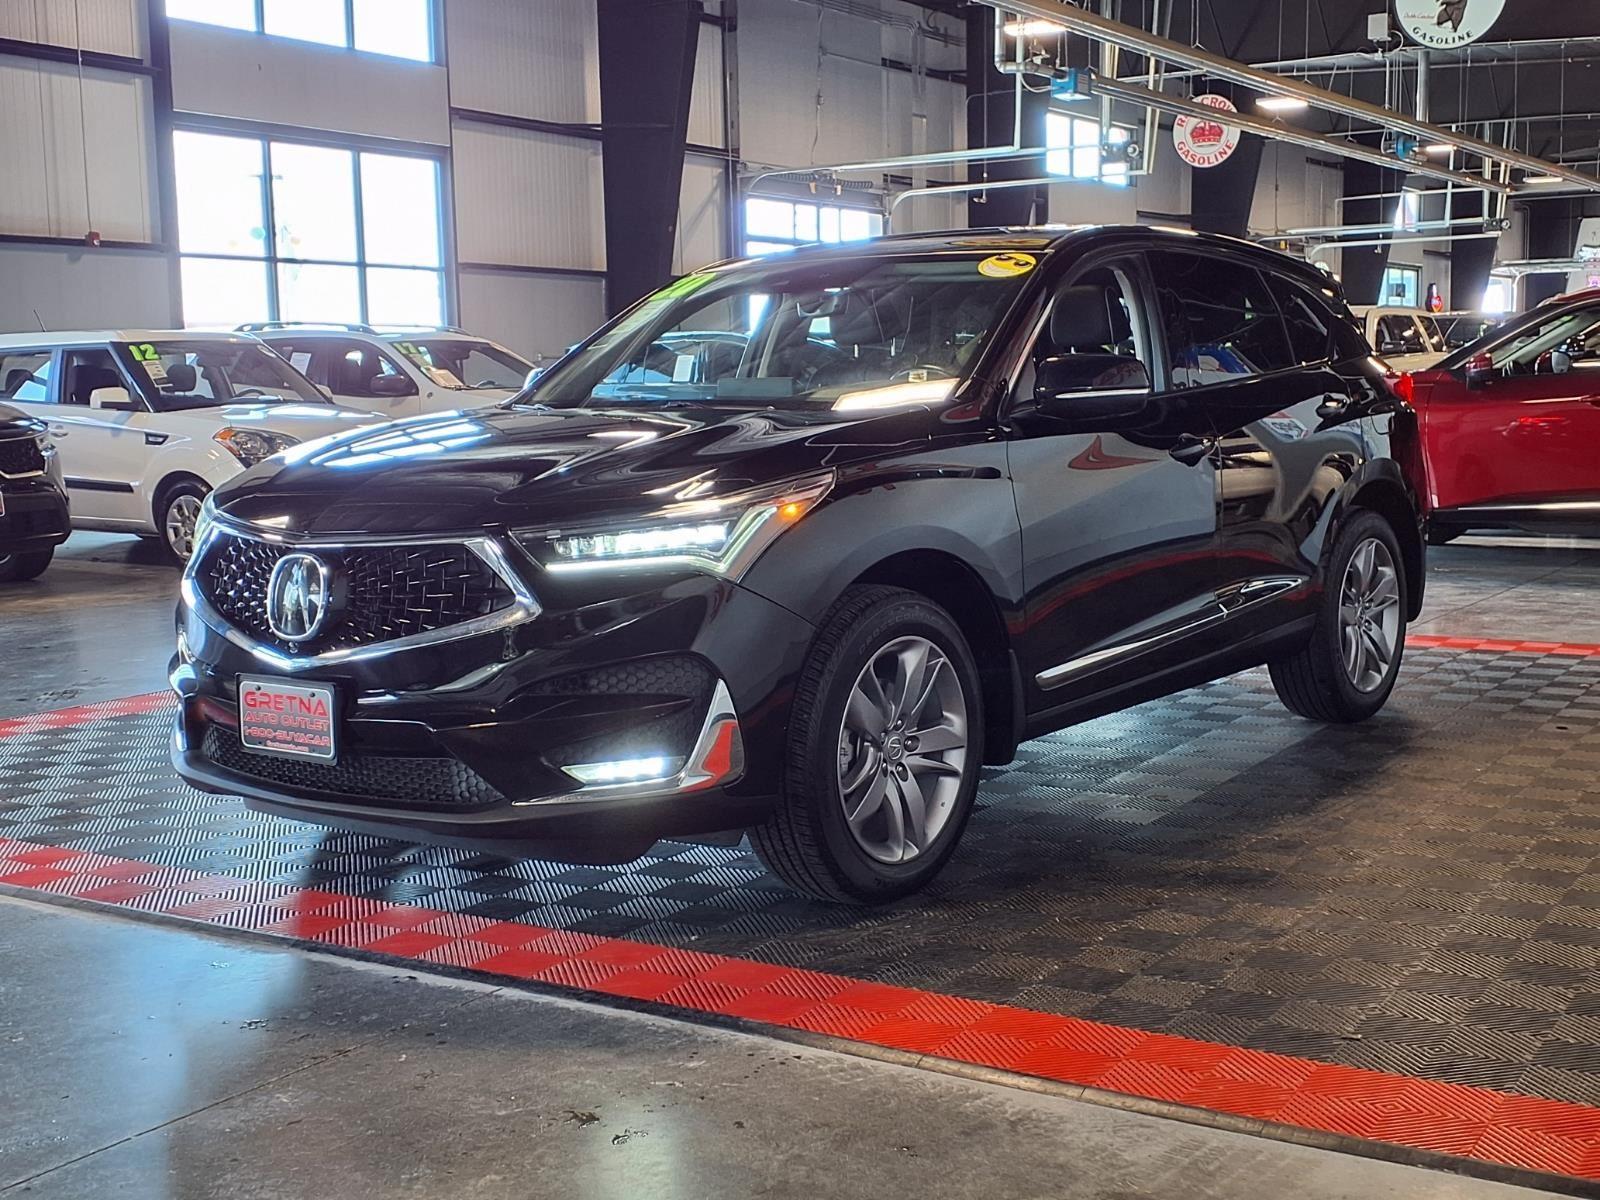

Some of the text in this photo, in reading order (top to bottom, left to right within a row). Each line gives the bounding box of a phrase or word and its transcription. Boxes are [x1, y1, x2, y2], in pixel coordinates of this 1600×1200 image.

[1412, 26, 1473, 44] GASOLINE
[1177, 140, 1234, 165] GASOLINE
[129, 344, 159, 360] 12
[244, 691, 328, 717] GRETNA
[244, 711, 329, 731] AUTO OUTLET
